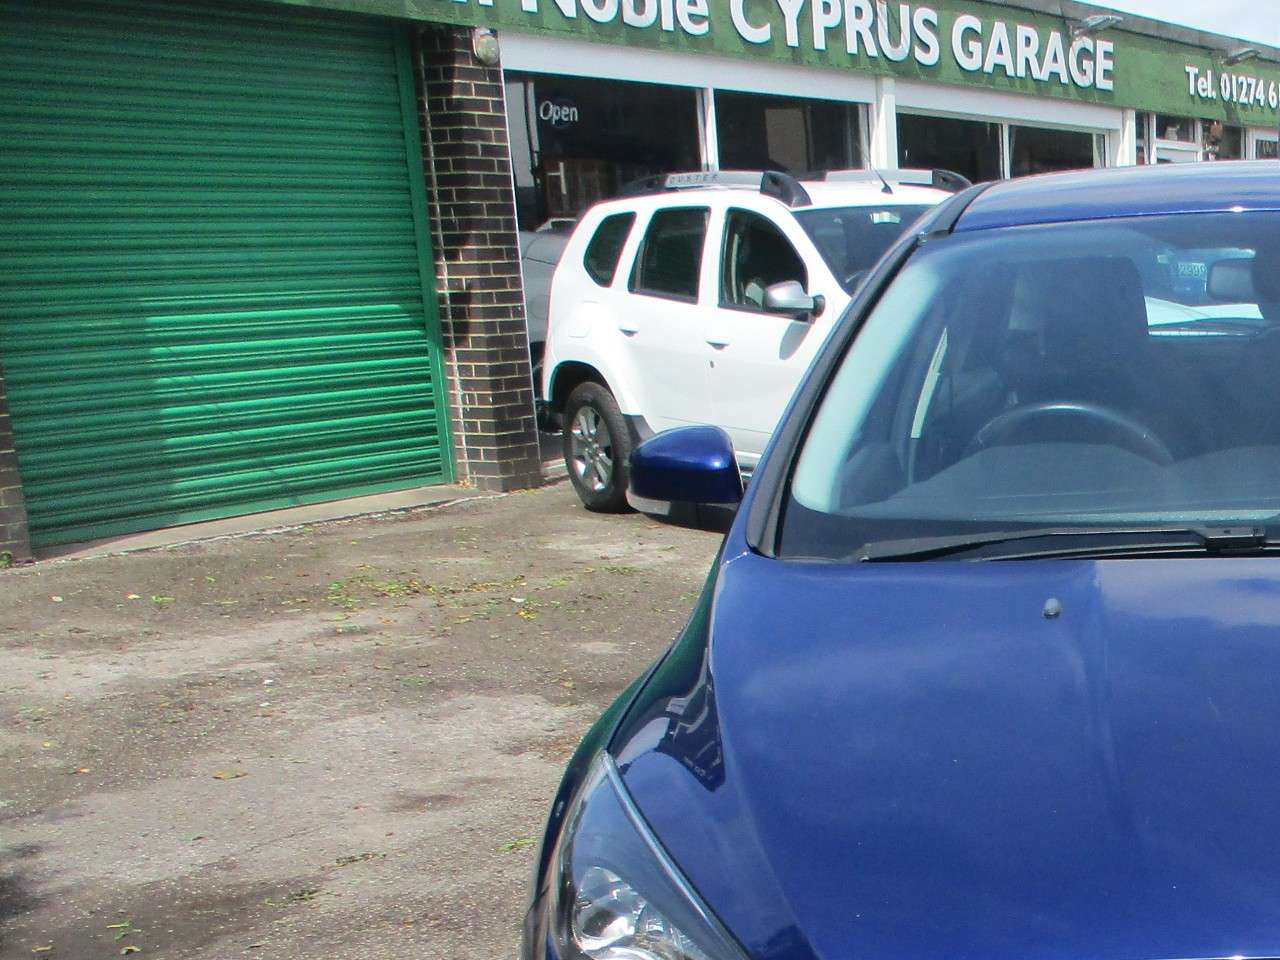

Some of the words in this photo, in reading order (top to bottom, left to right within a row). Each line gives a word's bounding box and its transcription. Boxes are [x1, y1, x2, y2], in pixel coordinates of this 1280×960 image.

[729, 0, 941, 67] CYPRUS
[952, 15, 1114, 92] GARAGE
[1185, 66, 1216, 99] Tel.
[1220, 73, 1265, 107] 01274
[539, 101, 579, 125] Open
